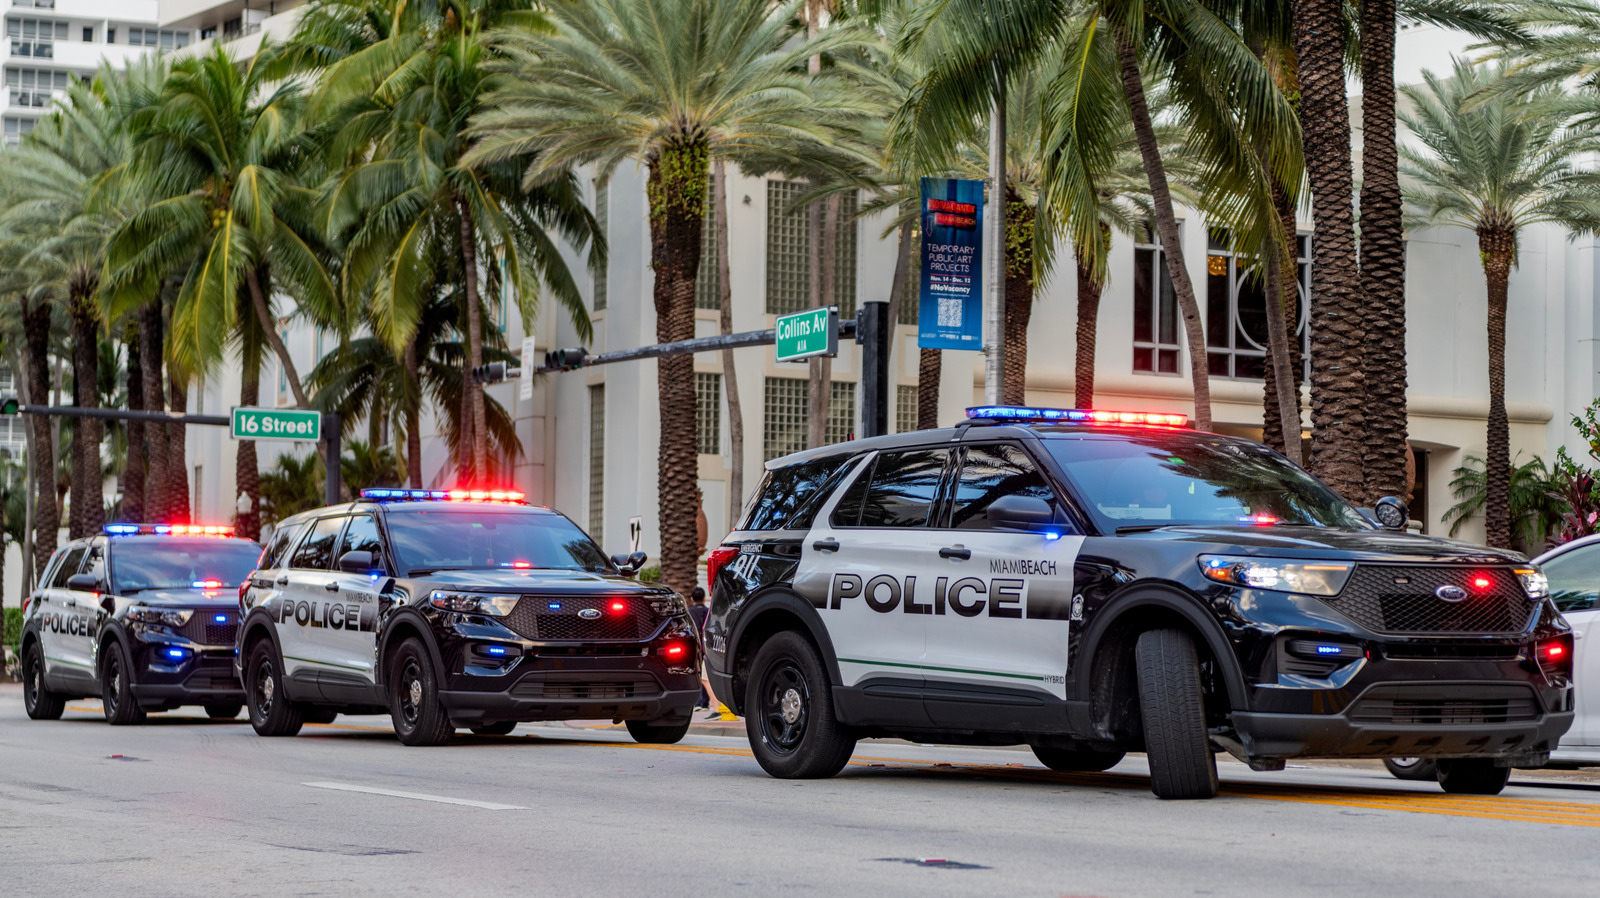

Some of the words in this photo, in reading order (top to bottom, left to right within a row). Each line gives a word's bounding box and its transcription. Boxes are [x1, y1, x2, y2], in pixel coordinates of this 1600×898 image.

[956, 216, 976, 225] BEACH
[928, 243, 975, 254] TEMPORARY
[929, 253, 954, 262] PUBLIC
[930, 262, 970, 272] PROJECTS
[930, 284, 970, 294] #NoVacancy
[778, 318, 810, 340] Collins
[813, 314, 826, 333] Av
[797, 340, 807, 352] A1A
[240, 414, 258, 433] 16
[262, 416, 314, 434] Street
[740, 544, 763, 552] EMERGENCY
[733, 555, 760, 580] 911
[830, 572, 1024, 618] POLICE
[281, 599, 360, 632] POLICE
[43, 612, 88, 636] POLICE
[1044, 675, 1064, 684] HYBRID
